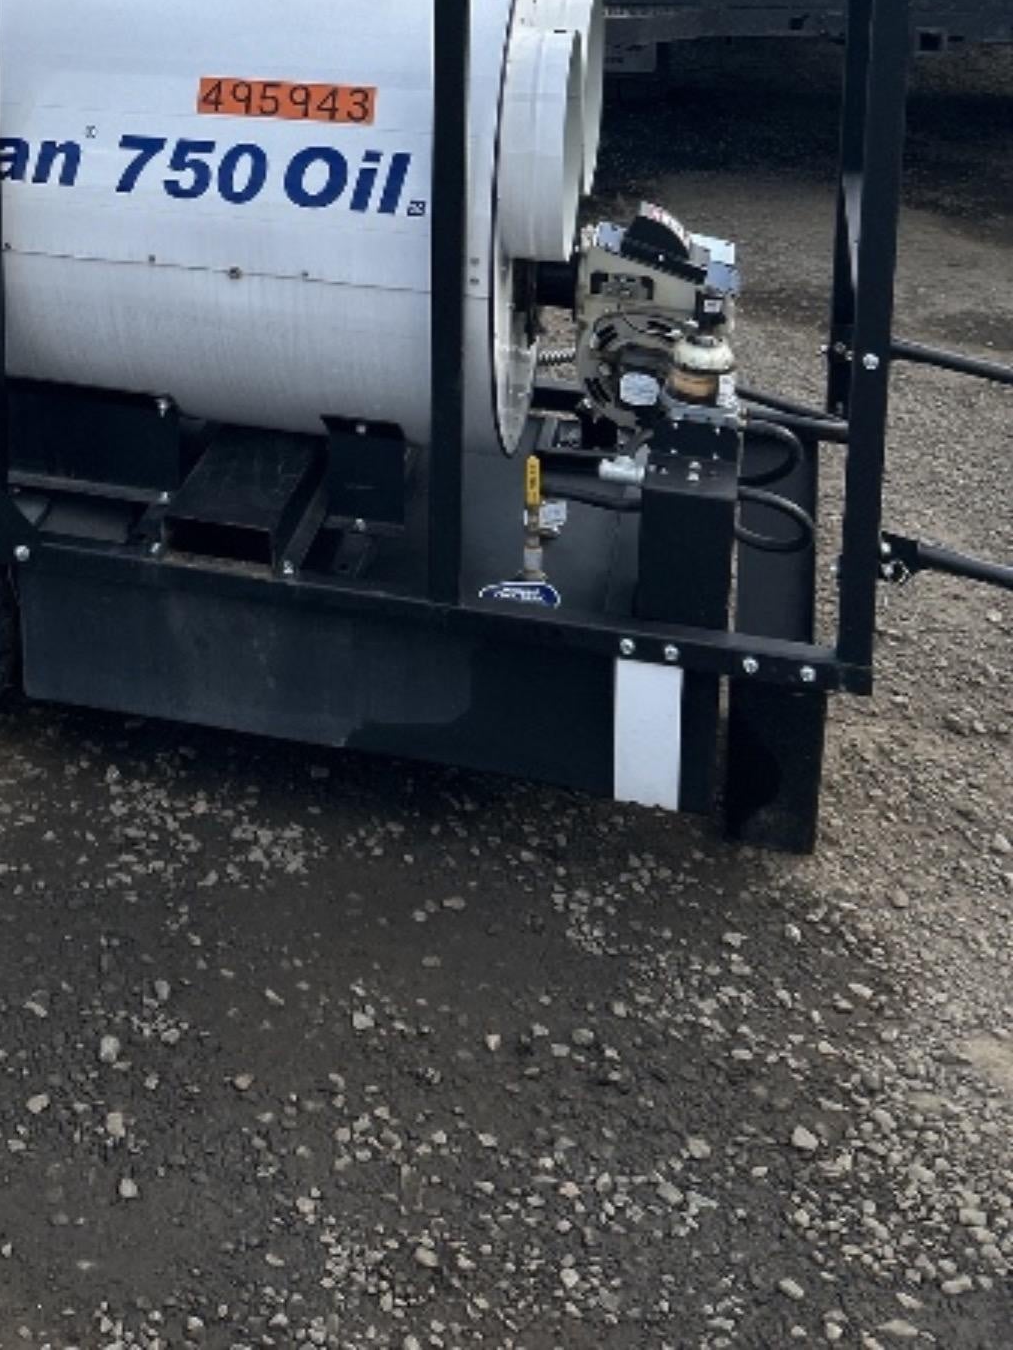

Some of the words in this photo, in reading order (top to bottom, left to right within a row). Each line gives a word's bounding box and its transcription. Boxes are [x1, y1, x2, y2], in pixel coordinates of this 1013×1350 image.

[200, 80, 369, 122] 495943
[116, 134, 268, 204] 750
[284, 146, 412, 214] Oil
